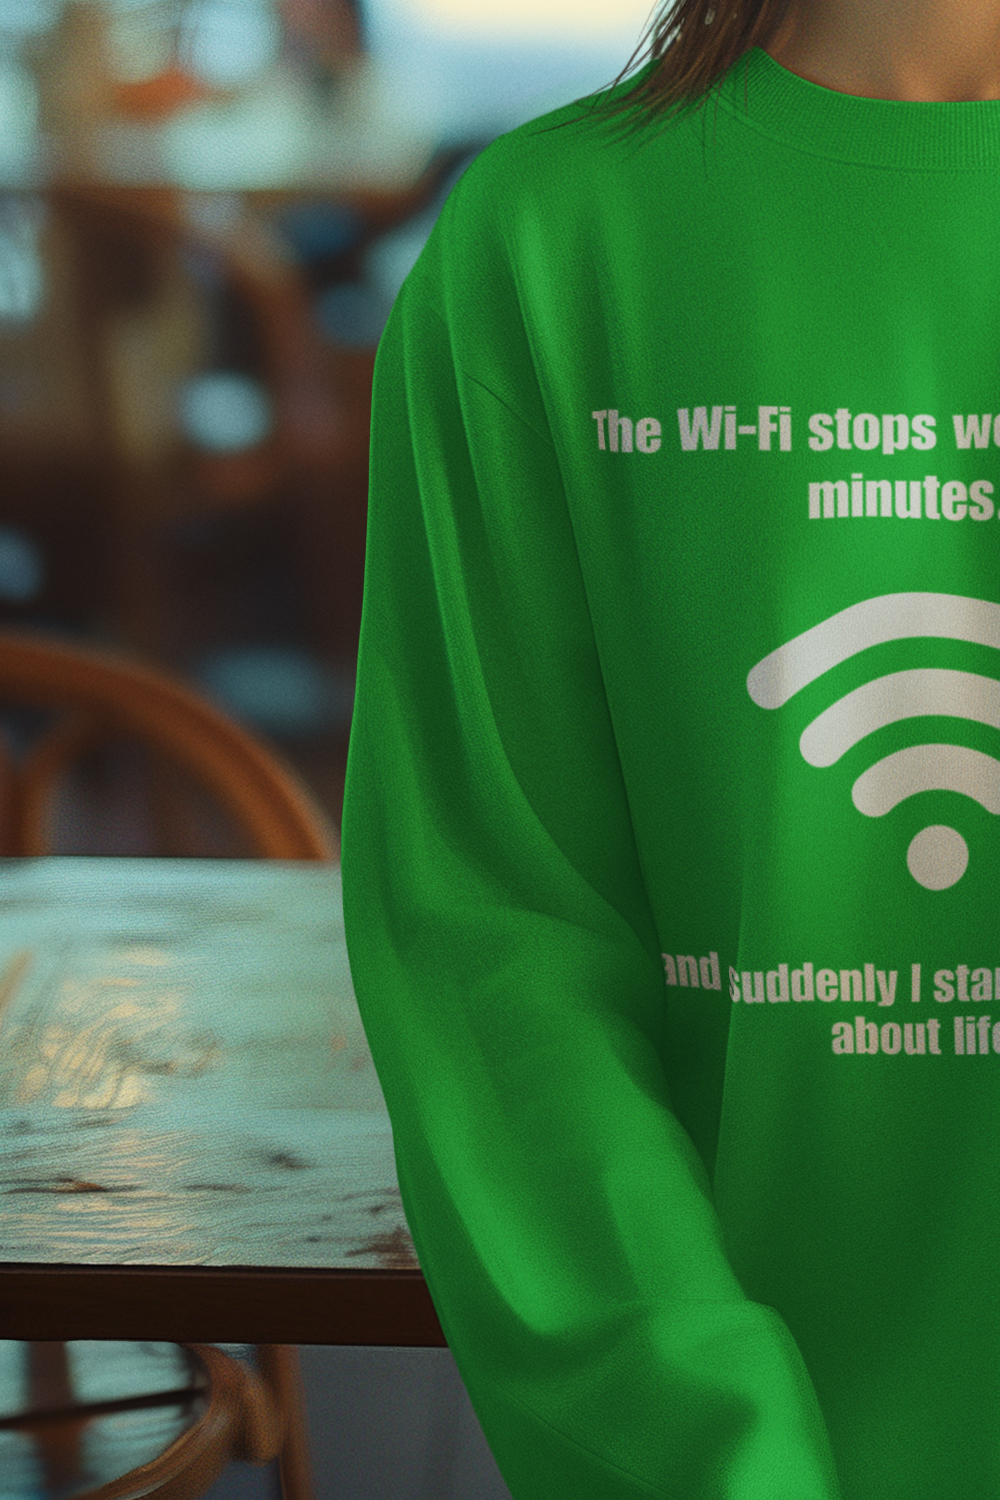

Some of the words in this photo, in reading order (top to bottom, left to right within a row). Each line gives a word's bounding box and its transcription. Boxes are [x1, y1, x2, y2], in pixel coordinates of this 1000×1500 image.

[590, 409, 662, 454] The
[678, 405, 792, 452] Wi-Fi
[808, 407, 938, 455] stops
[728, 961, 898, 1007] suddenly
[911, 964, 921, 1003] I
[831, 1016, 942, 1056] about
